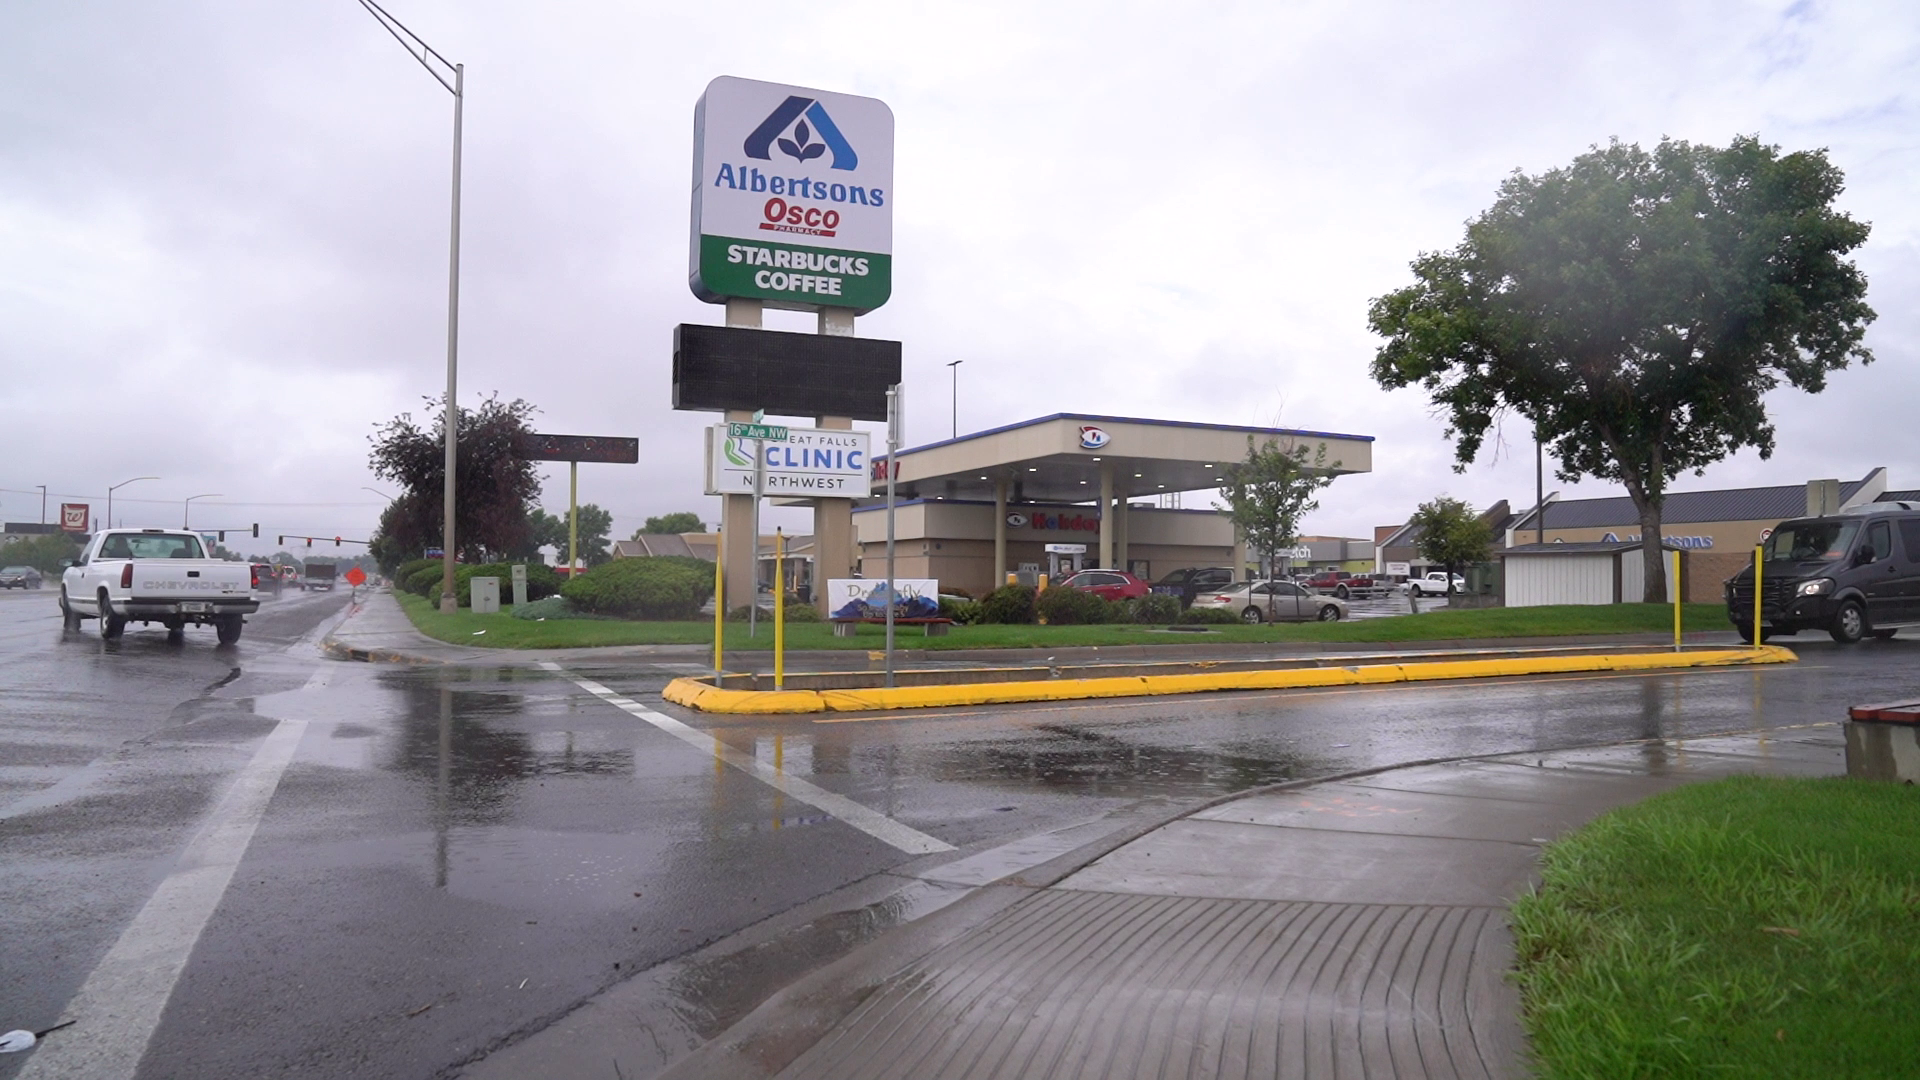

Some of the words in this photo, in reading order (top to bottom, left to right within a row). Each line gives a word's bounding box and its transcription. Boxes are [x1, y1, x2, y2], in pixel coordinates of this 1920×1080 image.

[715, 163, 884, 207] Albertsons
[773, 224, 821, 235] PHARMACY
[727, 244, 870, 276] STARBUCKS
[755, 270, 842, 296] COFFEE
[748, 425, 766, 438] Ave
[769, 427, 787, 439] NW
[819, 436, 858, 447] FALLS
[765, 446, 863, 470] CLINIC
[743, 475, 845, 489] NRTHWEST
[143, 580, 240, 590] CHEVROLET
